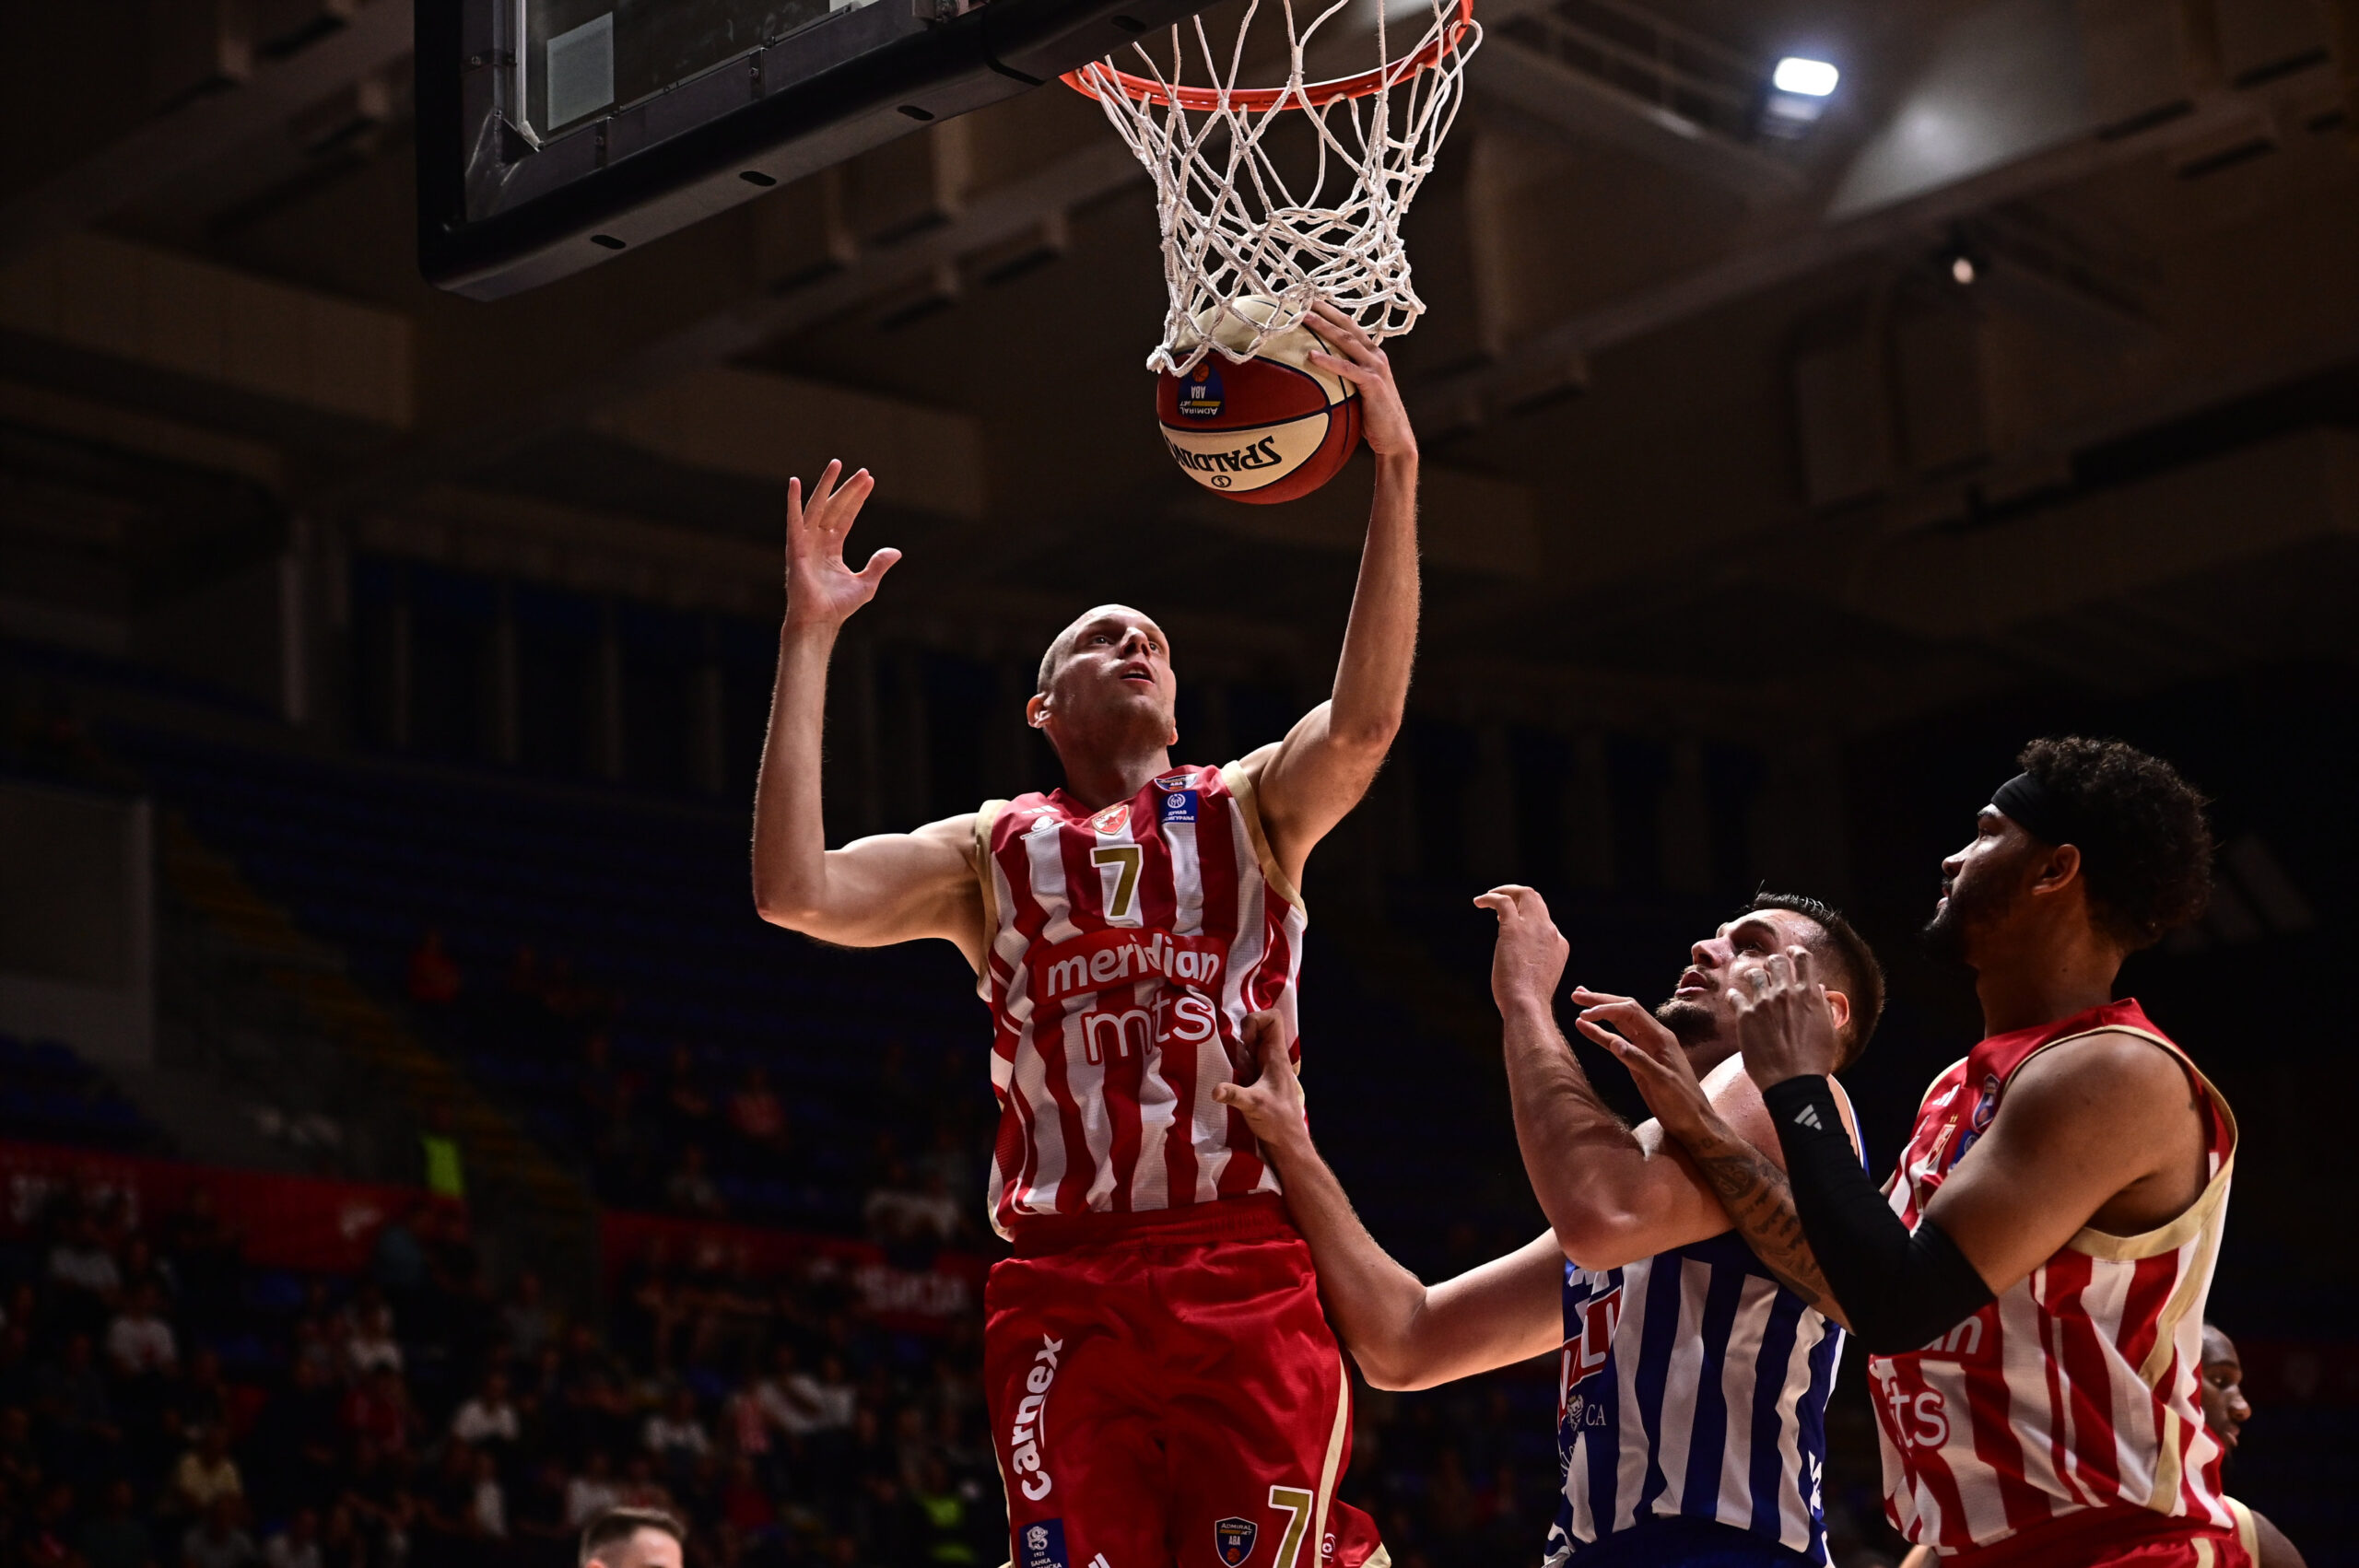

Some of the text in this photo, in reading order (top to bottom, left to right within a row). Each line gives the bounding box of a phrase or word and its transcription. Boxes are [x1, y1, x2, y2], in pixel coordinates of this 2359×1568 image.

[1180, 407, 1217, 415] ADMIRAL
[1191, 386, 1206, 399] ABA
[1090, 844, 1142, 919] 7
[1047, 933, 1220, 998] meridian
[1083, 990, 1214, 1062] mts
[1221, 1522, 1252, 1531] ADMIRAL
[1228, 1535, 1240, 1546] ABA
[1269, 1485, 1313, 1568] 7
